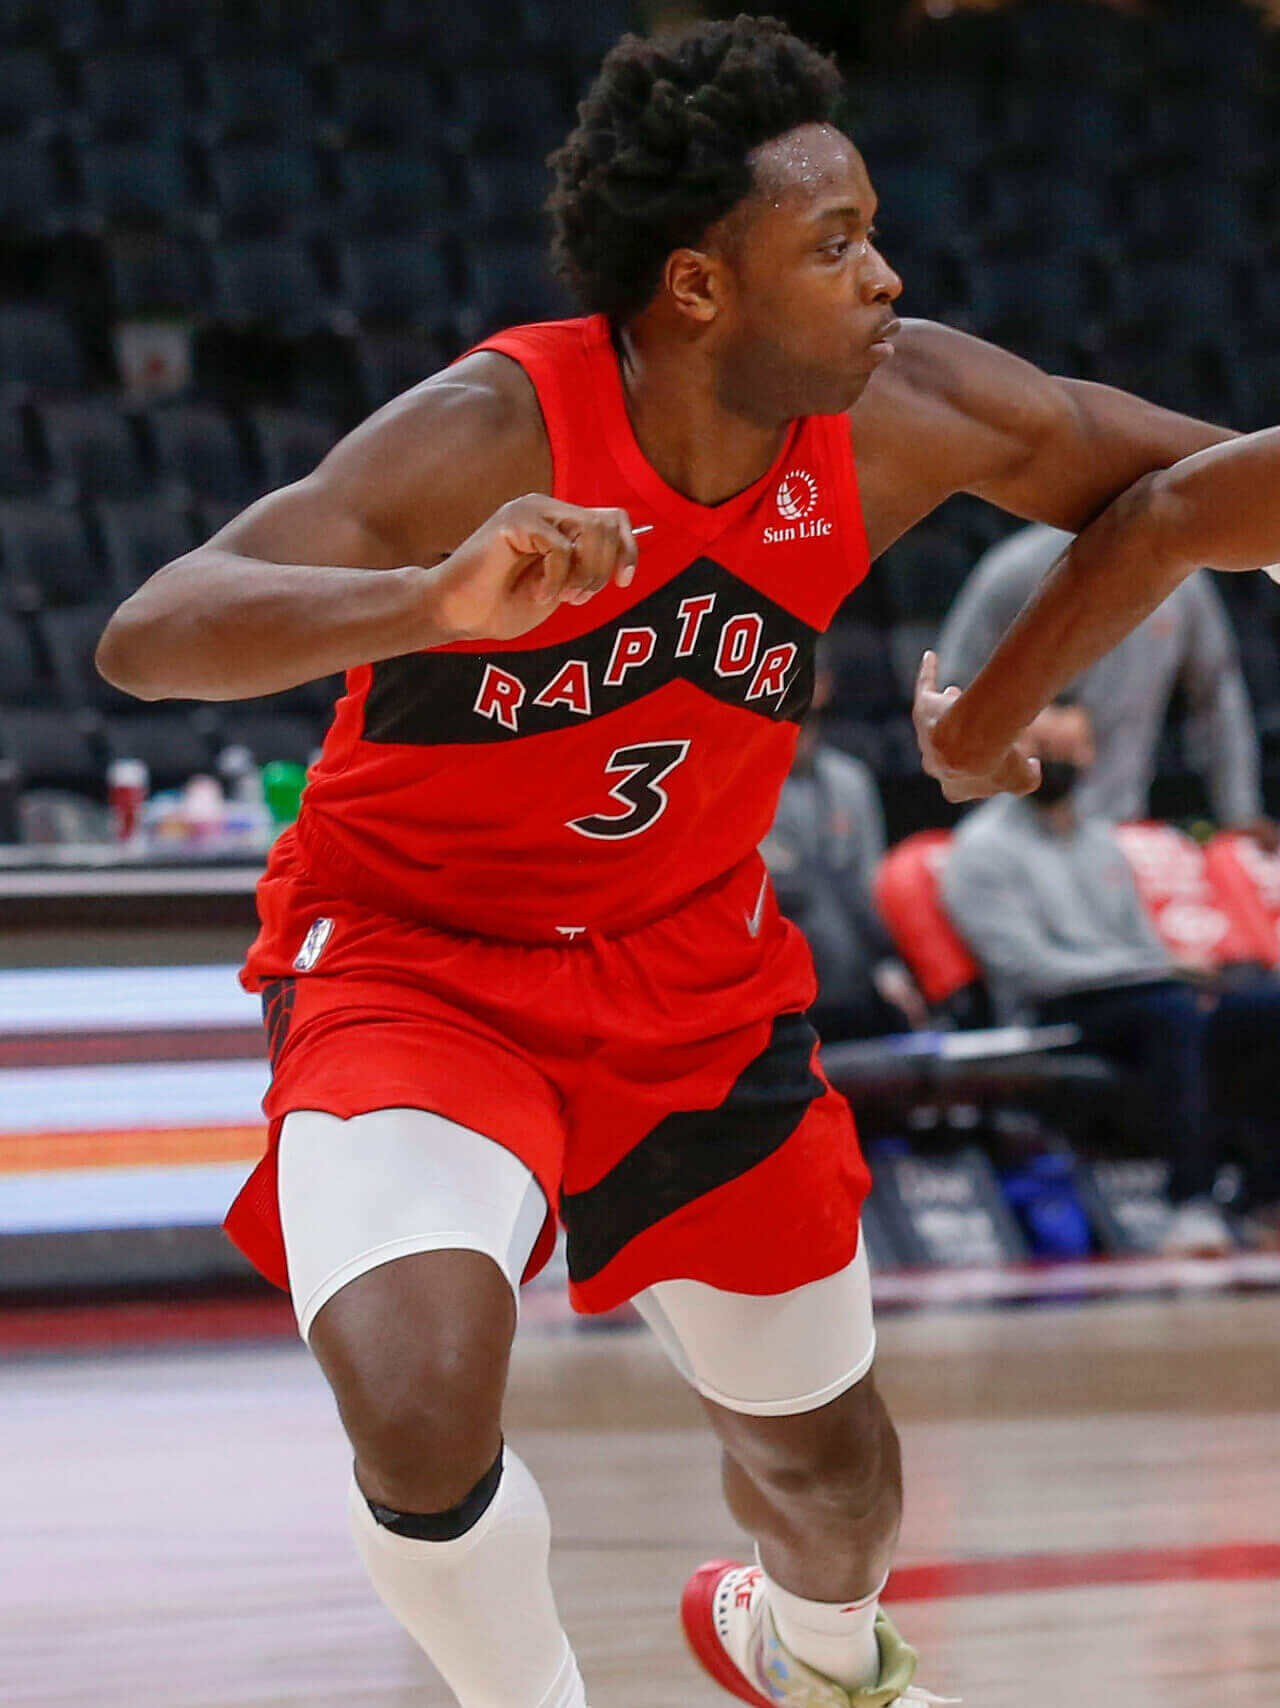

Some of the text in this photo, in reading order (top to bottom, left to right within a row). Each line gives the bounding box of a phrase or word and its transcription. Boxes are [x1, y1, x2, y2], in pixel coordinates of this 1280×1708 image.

[763, 517, 832, 544] Sun Life
[473, 593, 801, 732] RAPTOR
[564, 739, 692, 840] 3
